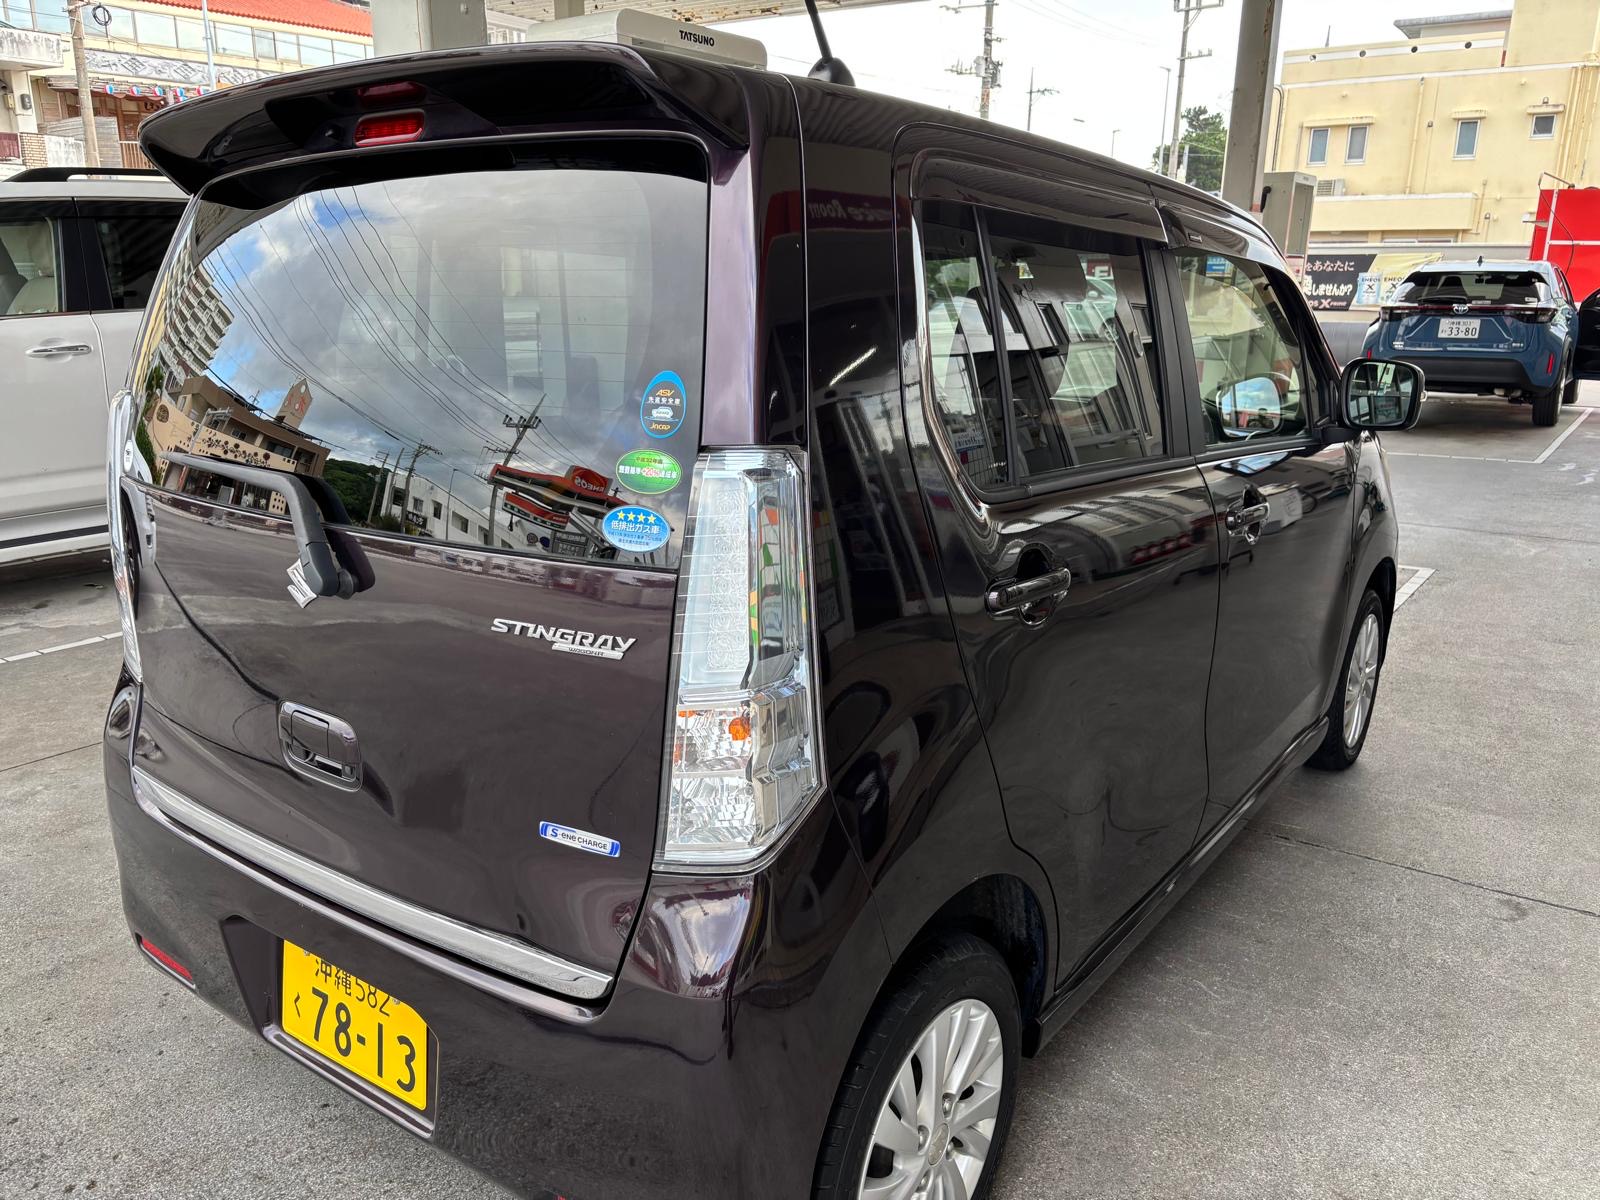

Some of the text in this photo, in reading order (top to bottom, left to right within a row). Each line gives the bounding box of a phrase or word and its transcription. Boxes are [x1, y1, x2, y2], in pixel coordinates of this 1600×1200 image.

[679, 29, 715, 47] TATSUNO
[1447, 327, 1477, 336] 33-80
[611, 520, 660, 534] 低排出ガス車
[491, 618, 637, 652] STINGRAY
[577, 837, 608, 850] CHARGE
[312, 986, 416, 1092] 78-13
